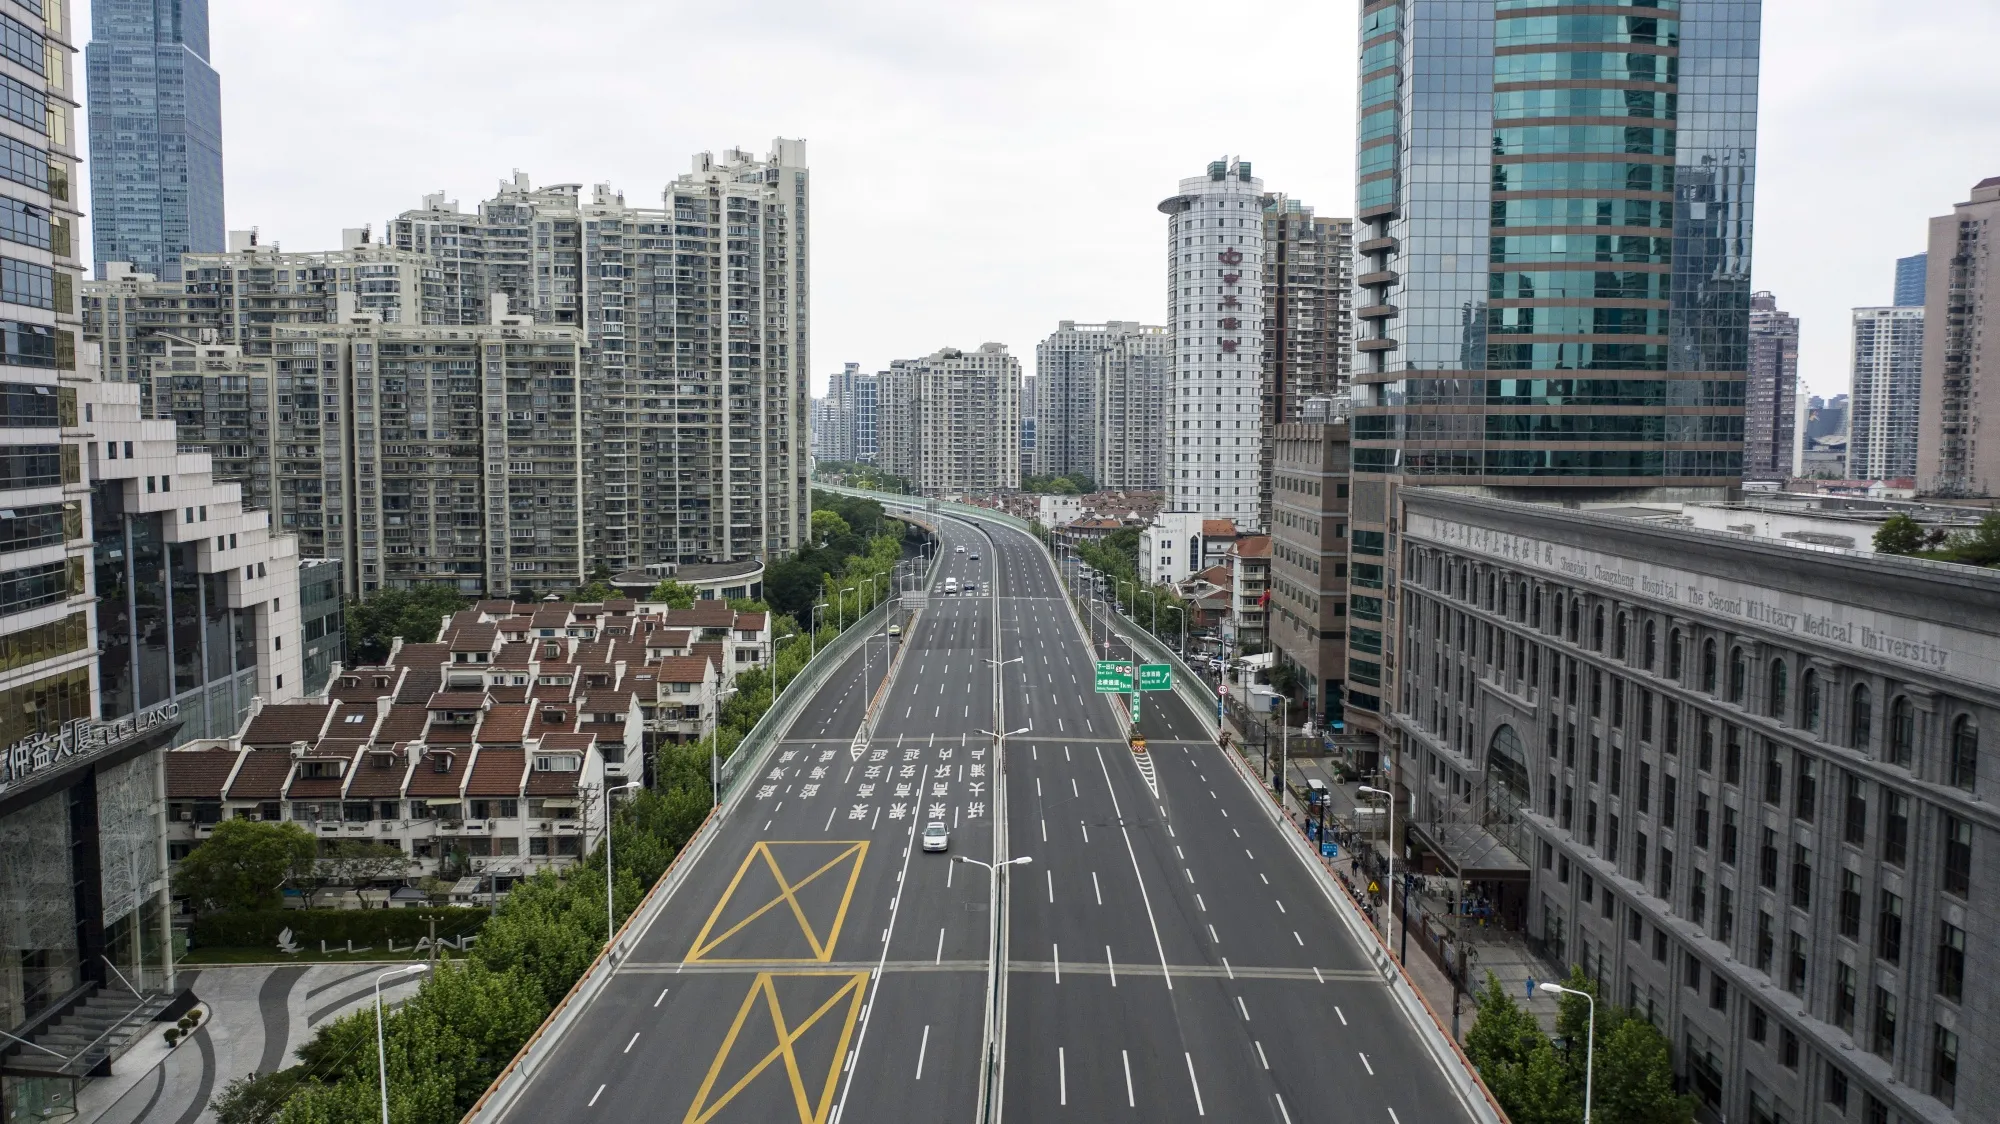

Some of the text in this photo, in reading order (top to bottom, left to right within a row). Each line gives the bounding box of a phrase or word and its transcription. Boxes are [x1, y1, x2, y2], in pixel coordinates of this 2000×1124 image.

[1560, 556, 1949, 671] Shanghai Changzheng Hospital The Second Military Medical University
[9, 718, 92, 780] 仲益大厦
[135, 703, 179, 733] LAND
[755, 750, 799, 800] 威海路
[799, 750, 837, 800] 威海路
[848, 749, 889, 820] 延安高架
[889, 749, 921, 820] 延安高架
[928, 748, 952, 820] 内环高架
[967, 747, 986, 819] 卢浦大桥
